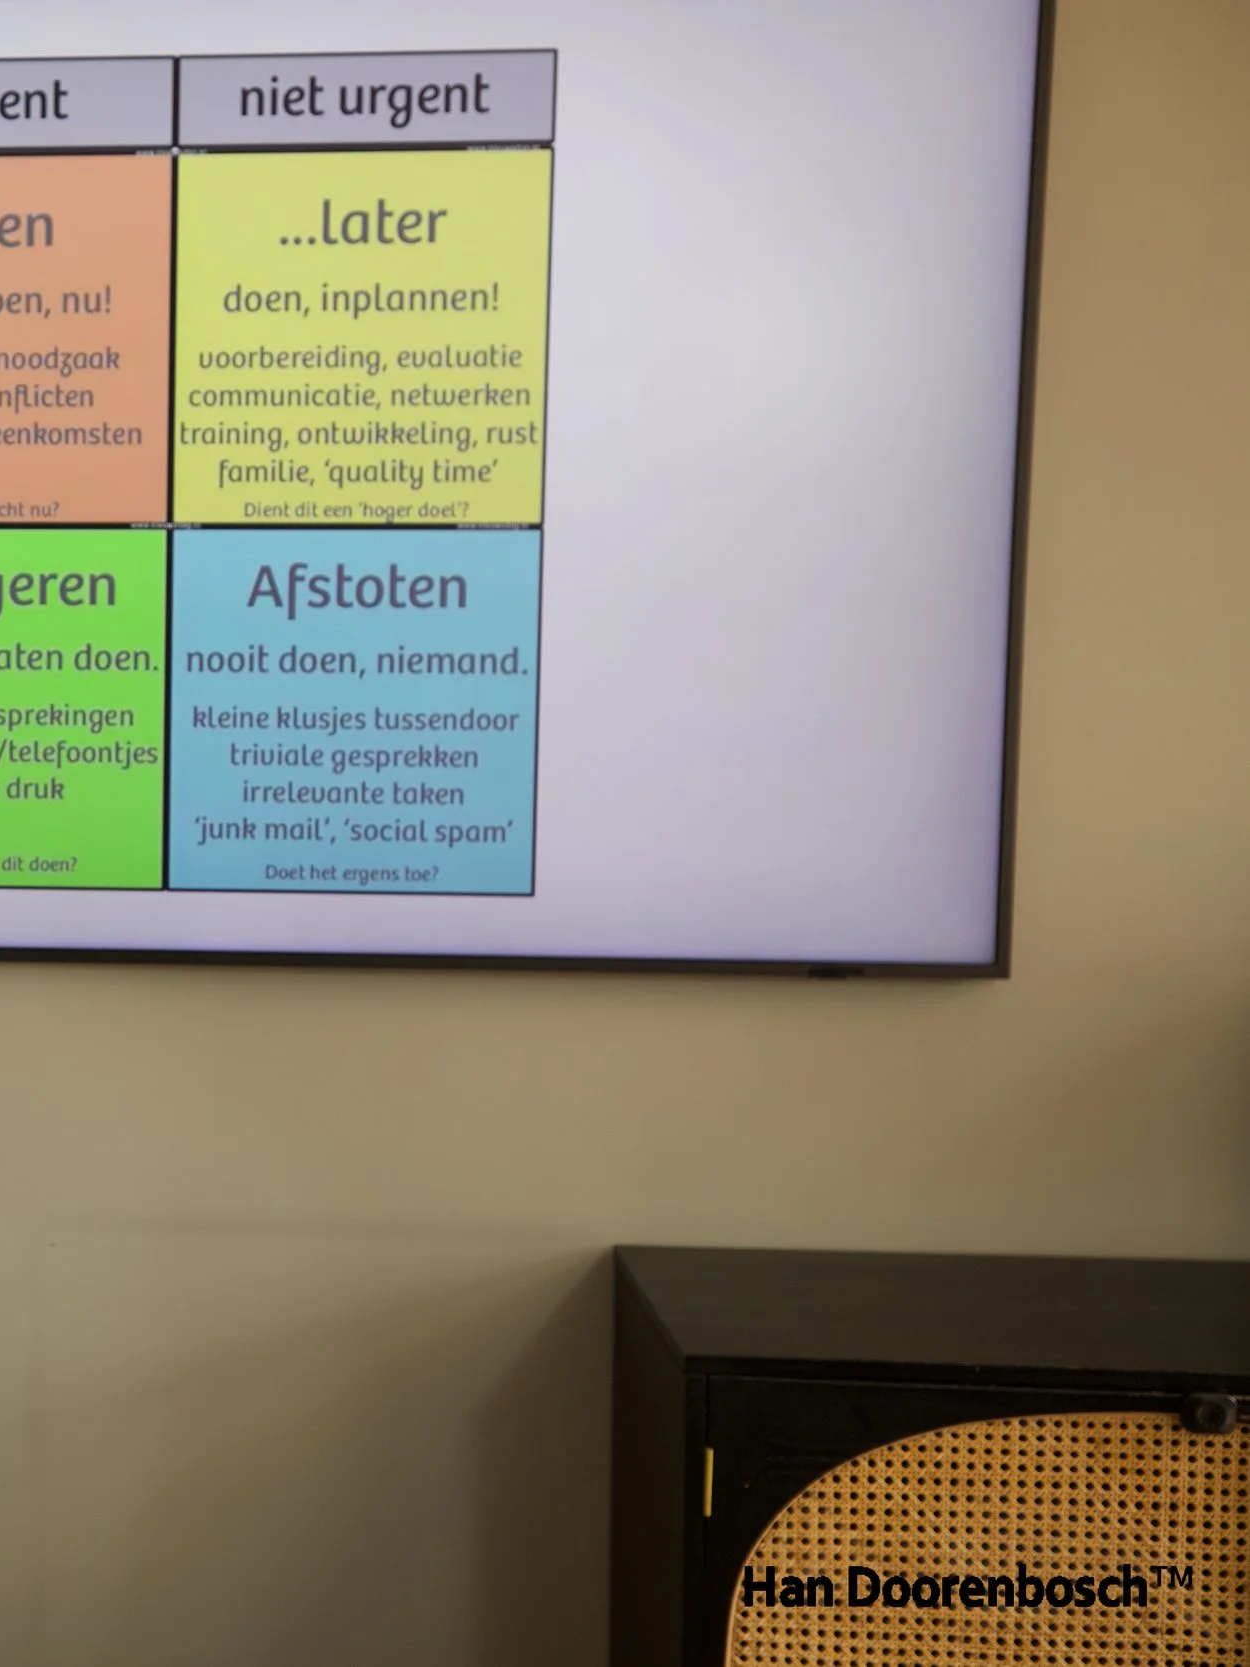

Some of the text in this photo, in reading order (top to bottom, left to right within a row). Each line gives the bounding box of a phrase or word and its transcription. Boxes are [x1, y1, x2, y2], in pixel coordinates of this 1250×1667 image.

[240, 72, 490, 129] niet urgent
[279, 198, 448, 246] ...later
[62, 284, 111, 315] nu!
[223, 281, 499, 321] doen, inplannen!
[198, 343, 523, 377] voorbereiding, evaluatie
[188, 382, 531, 411] communicatie, netwerken
[179, 420, 538, 454] training, ontwikkeling, rust
[218, 458, 315, 489] familie,
[29, 500, 61, 519] nu?
[243, 501, 290, 518] Dient
[294, 501, 319, 519] dit
[322, 504, 353, 518] een
[246, 562, 467, 621] Afstoten
[73, 642, 159, 672] doen.
[186, 644, 528, 679] nooit doen, niemand.
[192, 705, 520, 737] kleine klusjes tussendoor
[230, 742, 479, 775] triviale gesprekken
[5, 777, 65, 800] druk
[242, 779, 465, 806] irrelevante taken
[0, 856, 24, 872] dit
[28, 855, 78, 873] doen?
[264, 863, 440, 887] Doet het ergens toe?
